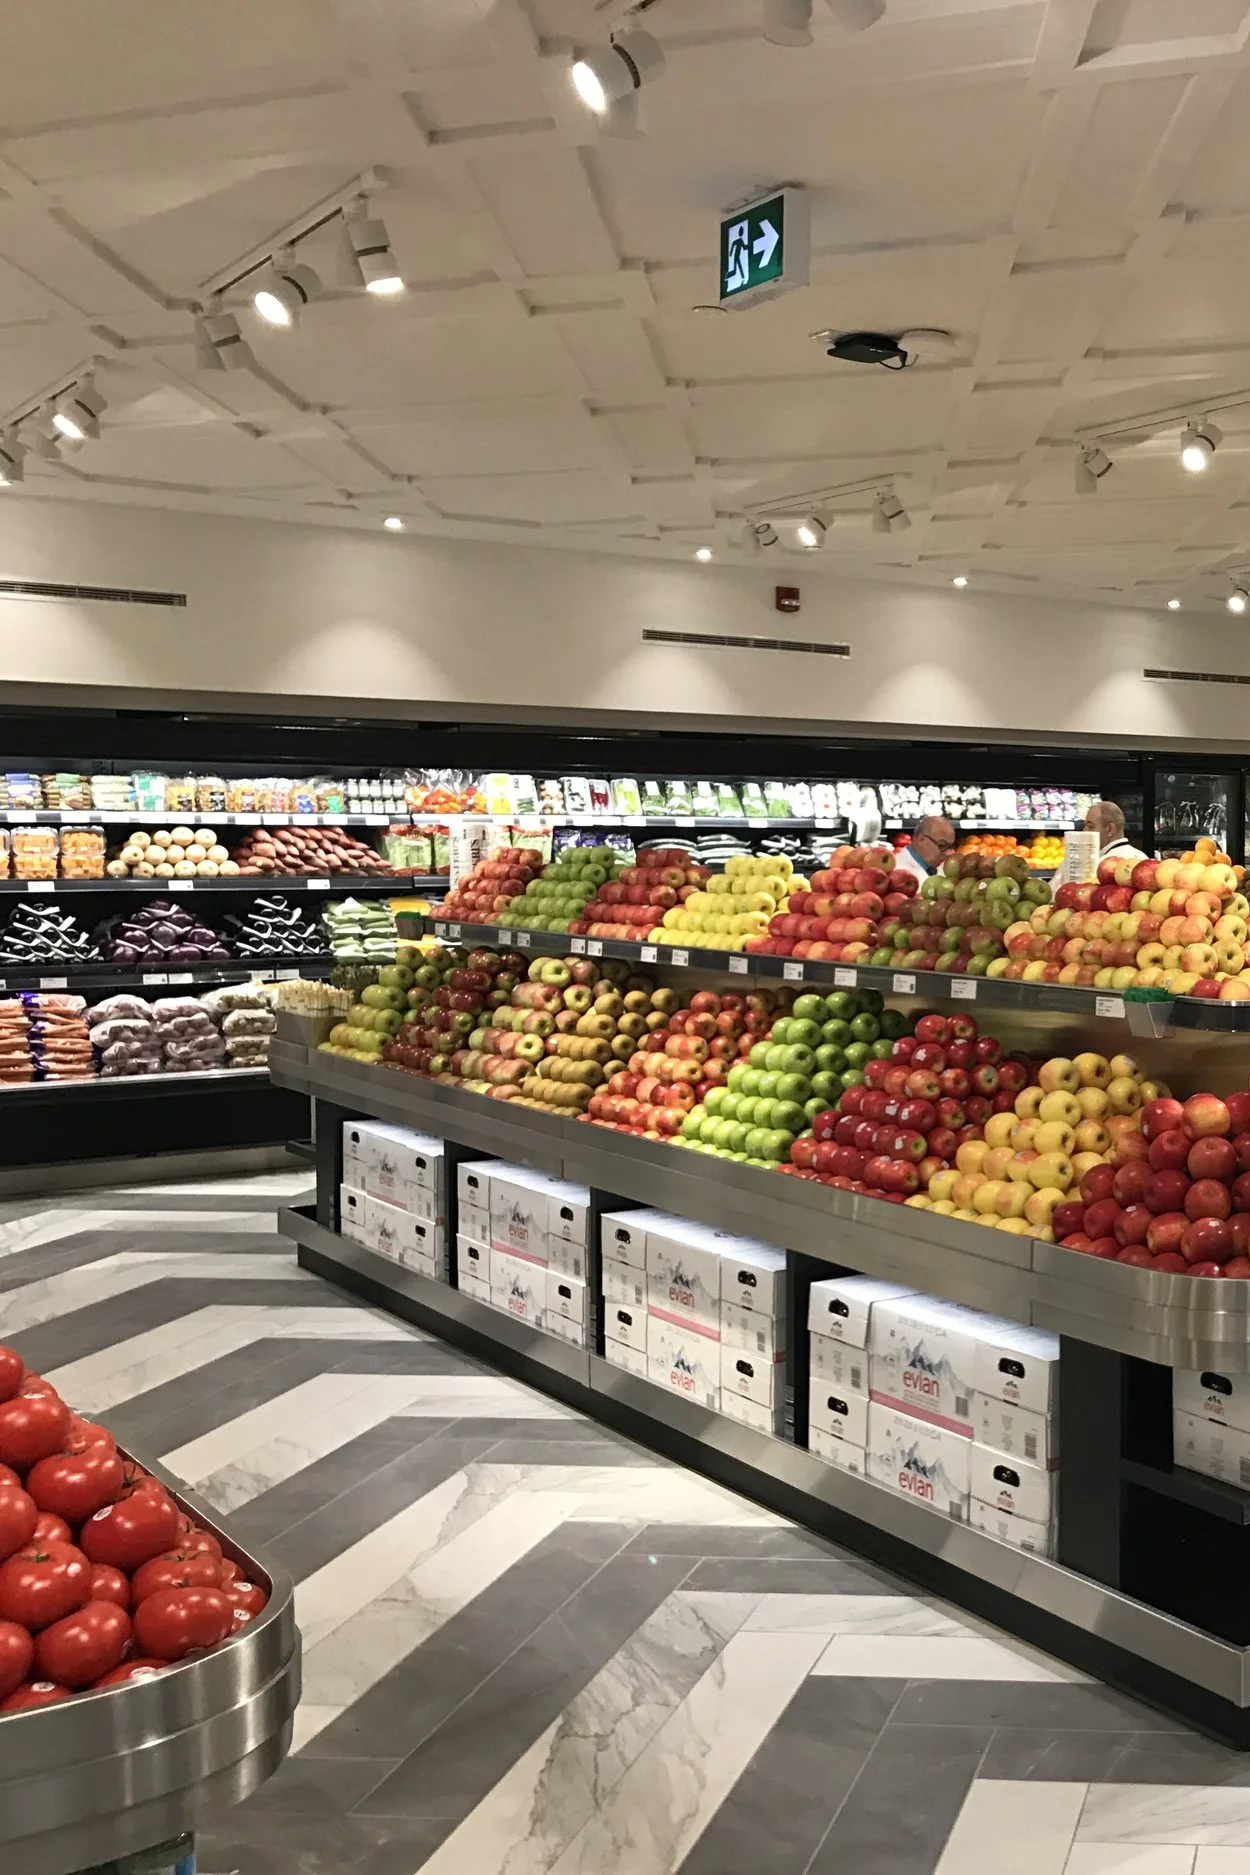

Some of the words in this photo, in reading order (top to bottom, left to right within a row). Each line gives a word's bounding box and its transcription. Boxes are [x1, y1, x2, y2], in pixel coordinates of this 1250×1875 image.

[508, 1222, 529, 1239] evian
[508, 1299, 528, 1317] evian
[669, 1286, 695, 1308] evian
[670, 1370, 697, 1394] evian
[903, 1369, 940, 1398] evian
[899, 1471, 934, 1501] evian
